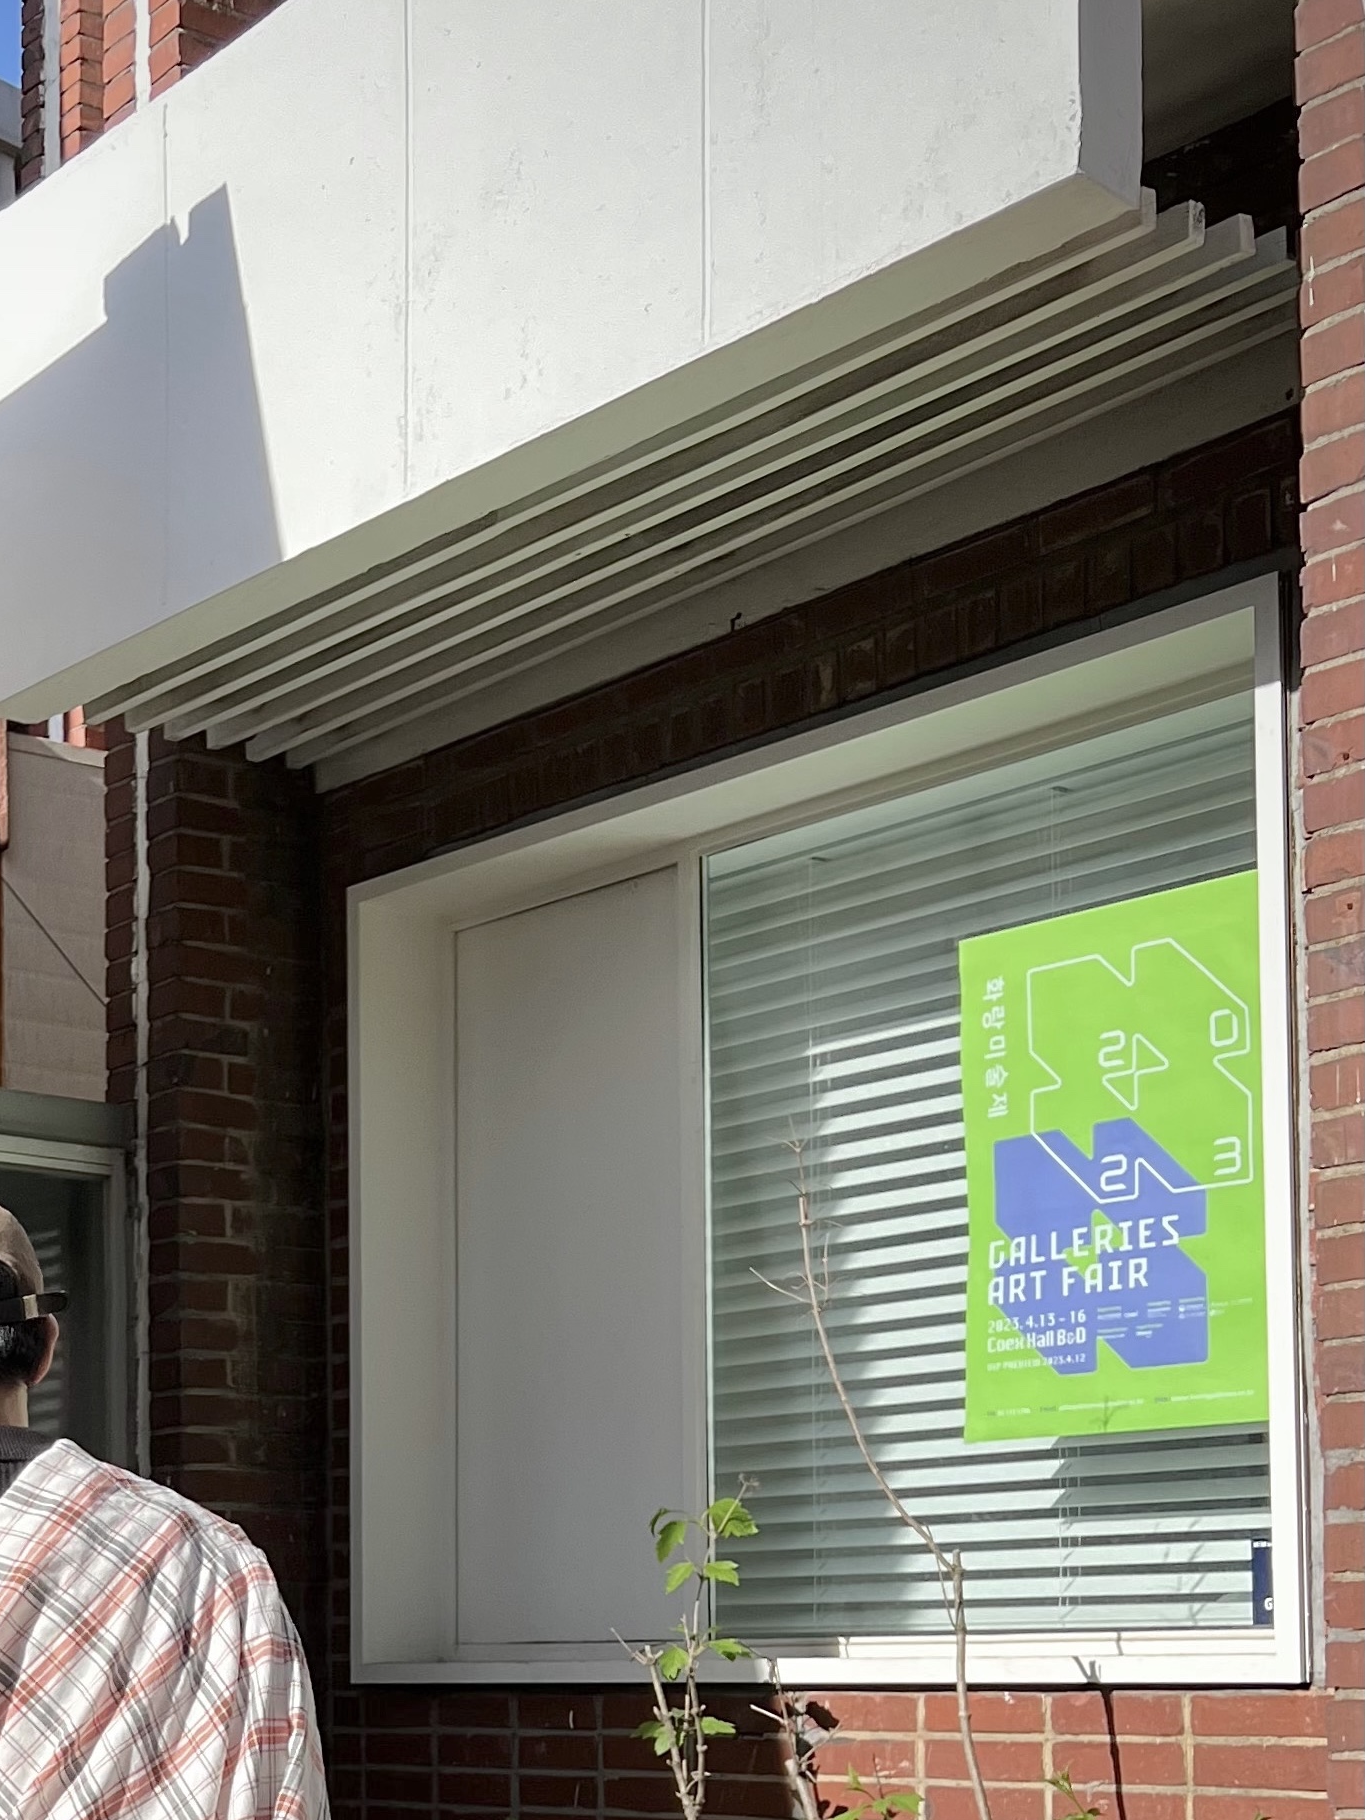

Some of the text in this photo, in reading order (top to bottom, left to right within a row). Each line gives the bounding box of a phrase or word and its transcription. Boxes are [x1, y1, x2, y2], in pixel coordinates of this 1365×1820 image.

[982, 976, 1008, 1118] 화랑미술제
[1098, 1030, 1125, 1067] 2
[1100, 1136, 1242, 1192] 2 3
[988, 1214, 1180, 1270] GALLERIES
[988, 1257, 1149, 1306] ART FAIR
[987, 1336, 1025, 1353] Coex
[1026, 1330, 1055, 1349] Hall
